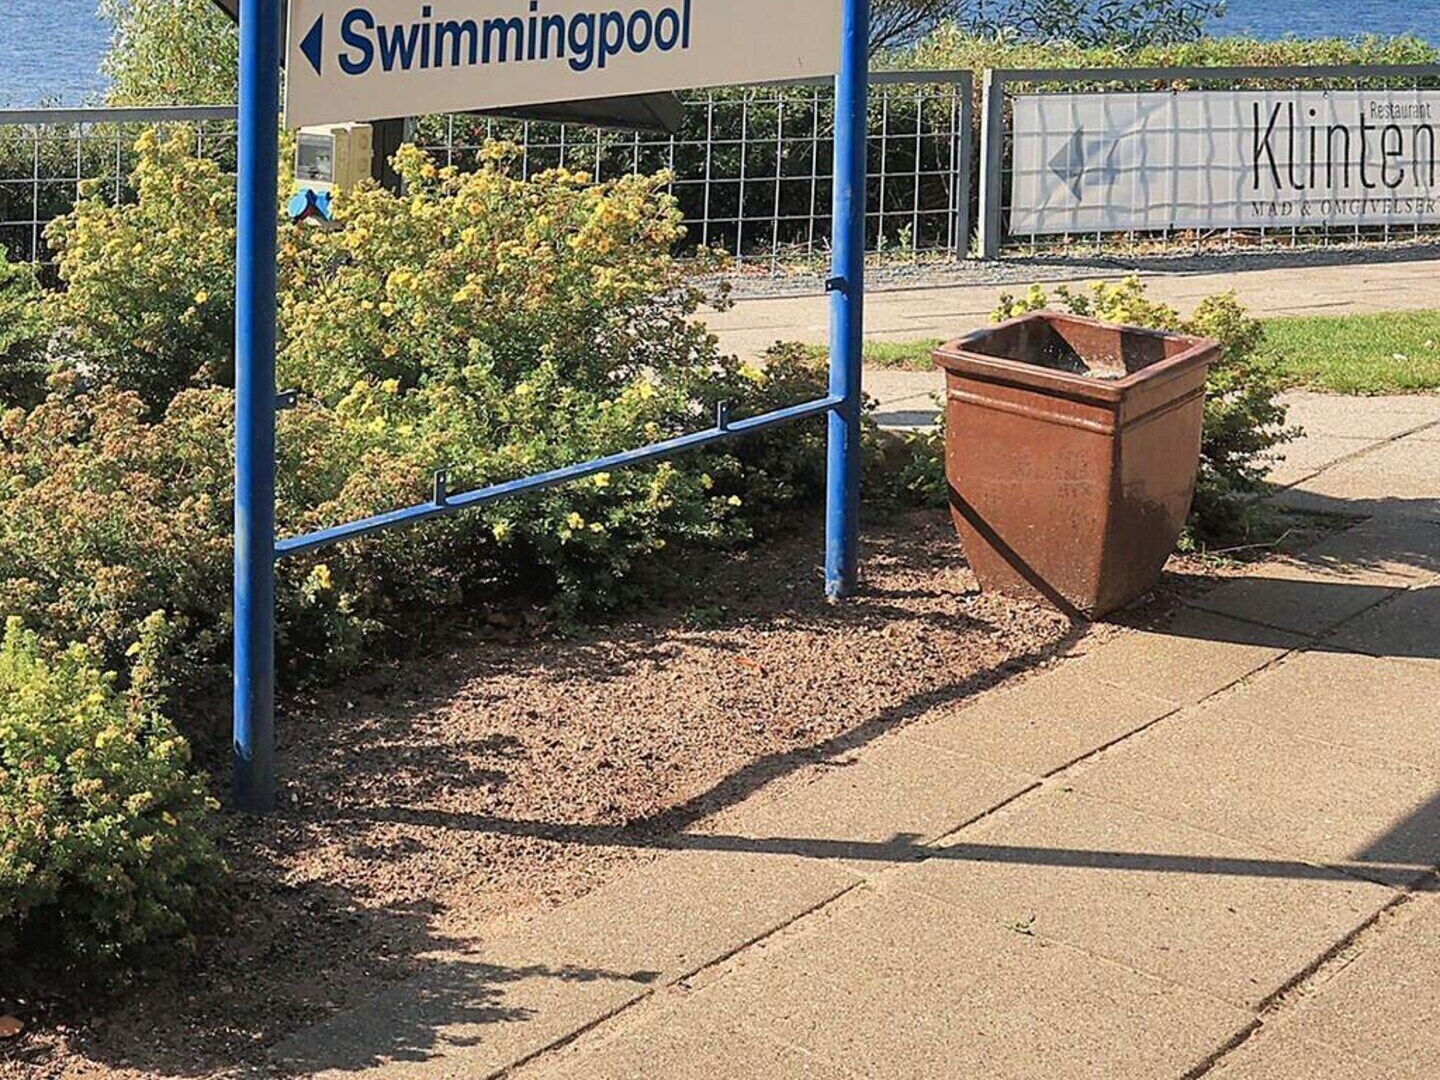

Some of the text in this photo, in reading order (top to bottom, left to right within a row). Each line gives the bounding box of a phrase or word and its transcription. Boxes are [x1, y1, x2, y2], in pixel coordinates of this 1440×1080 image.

[1370, 101, 1432, 120] Restaurant
[1253, 102, 1435, 190] Klinten
[1252, 200, 1293, 217] MAD
[1300, 200, 1312, 217] &
